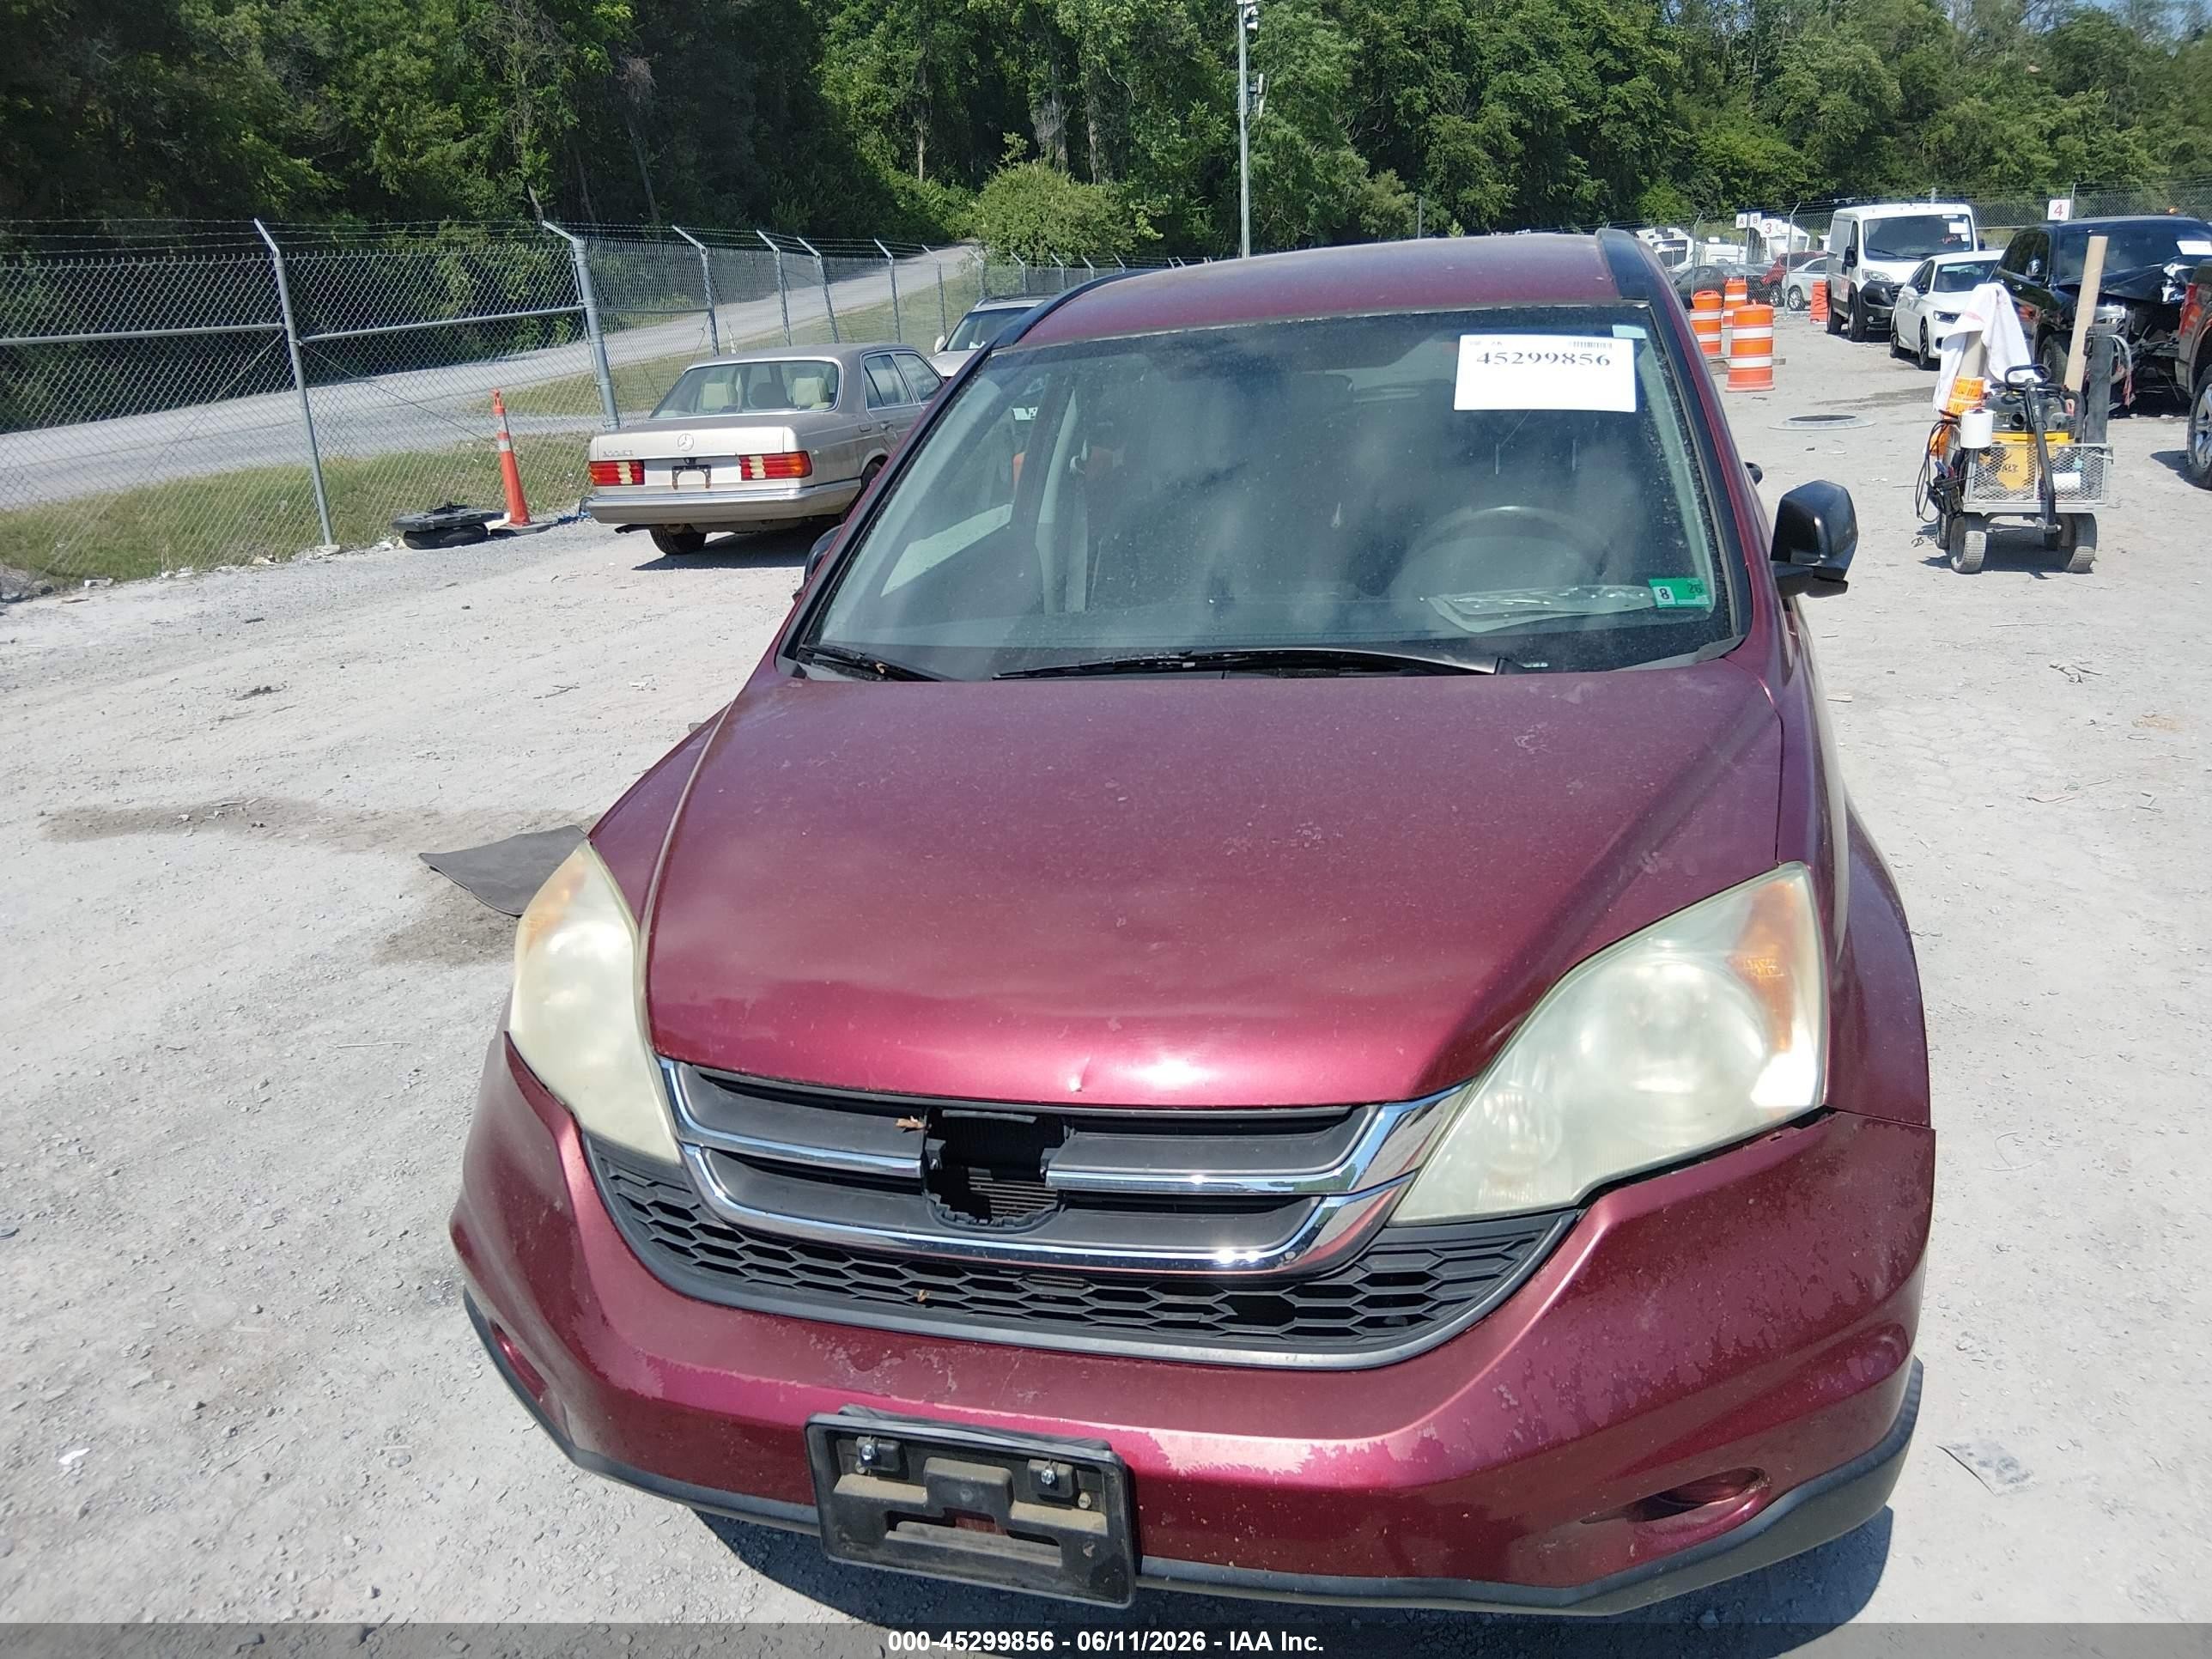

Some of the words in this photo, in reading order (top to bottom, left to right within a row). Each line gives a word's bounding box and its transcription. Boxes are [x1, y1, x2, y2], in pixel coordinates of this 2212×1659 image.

[2053, 204, 2063, 216] 4
[1738, 217, 1745, 226] A
[1753, 216, 1758, 224] B
[1765, 222, 1772, 234] 3
[1476, 351, 1611, 366] 45299856
[1659, 588, 1669, 599] 8
[1688, 583, 1703, 594] 26
